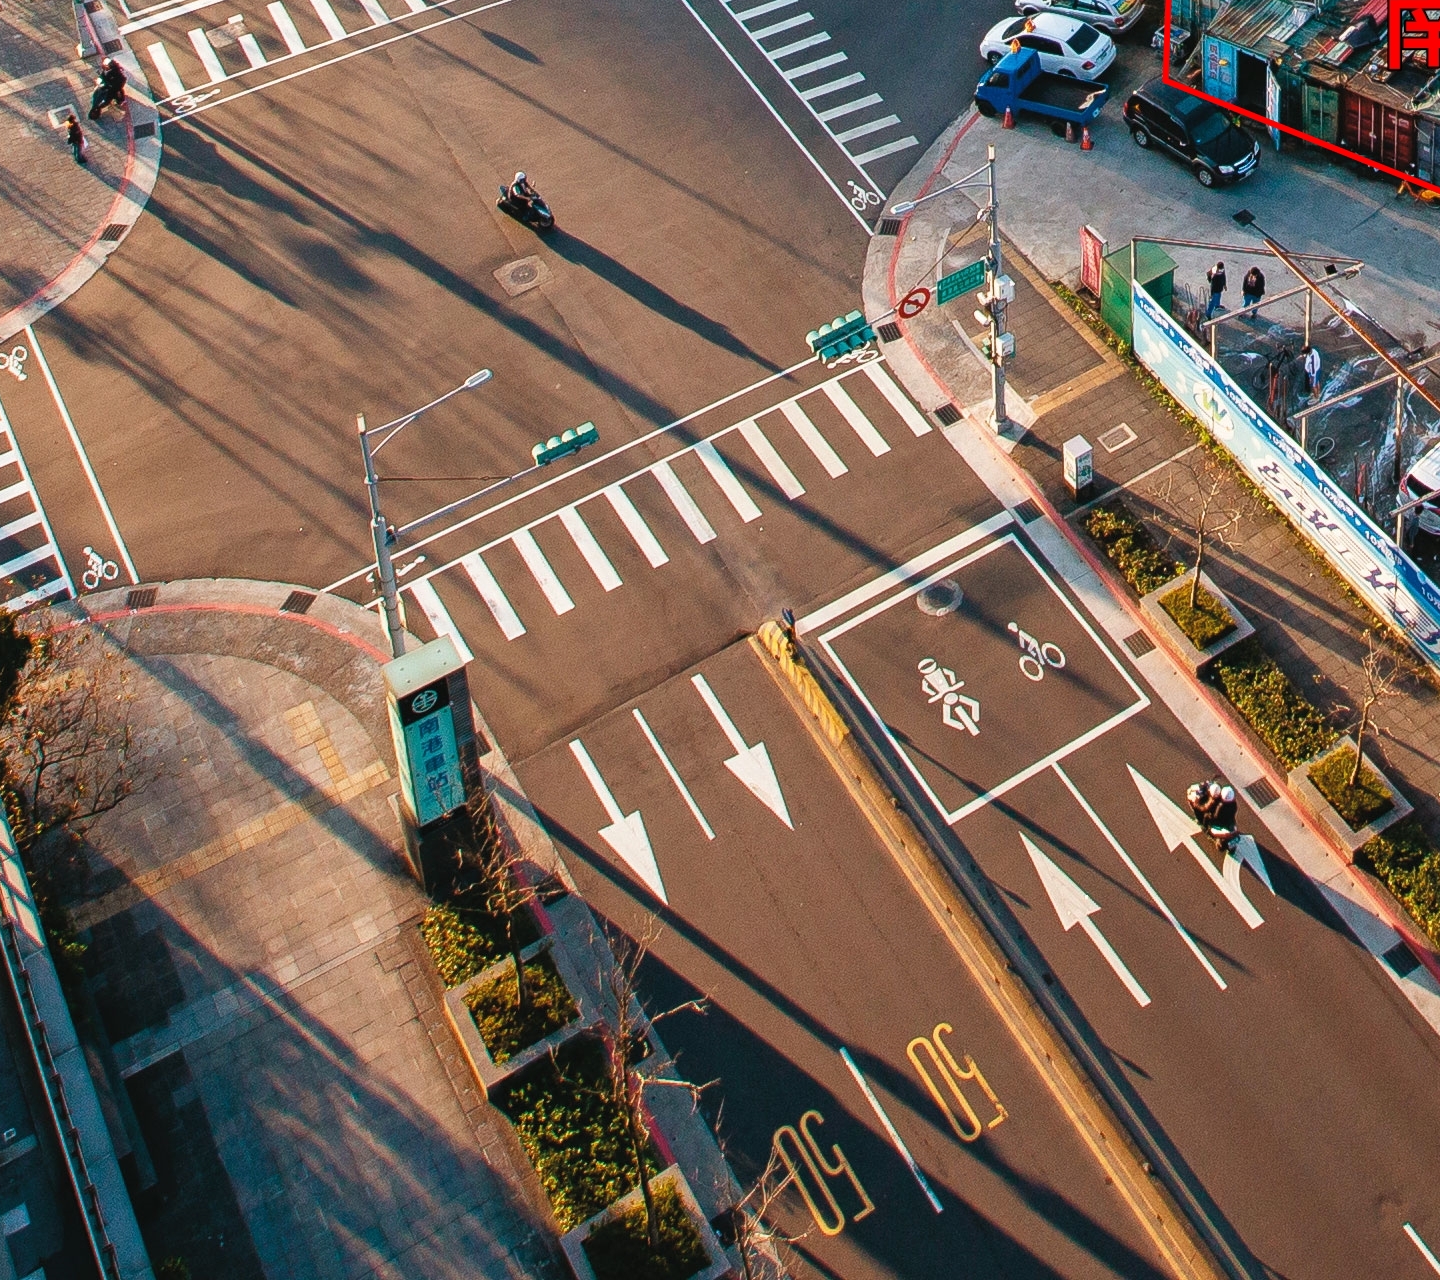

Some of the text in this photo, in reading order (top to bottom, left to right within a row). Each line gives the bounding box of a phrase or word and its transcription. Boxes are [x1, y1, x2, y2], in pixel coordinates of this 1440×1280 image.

[417, 714, 450, 794] 南港車站
[905, 1021, 1008, 1144] 50
[772, 1109, 876, 1237] 50
